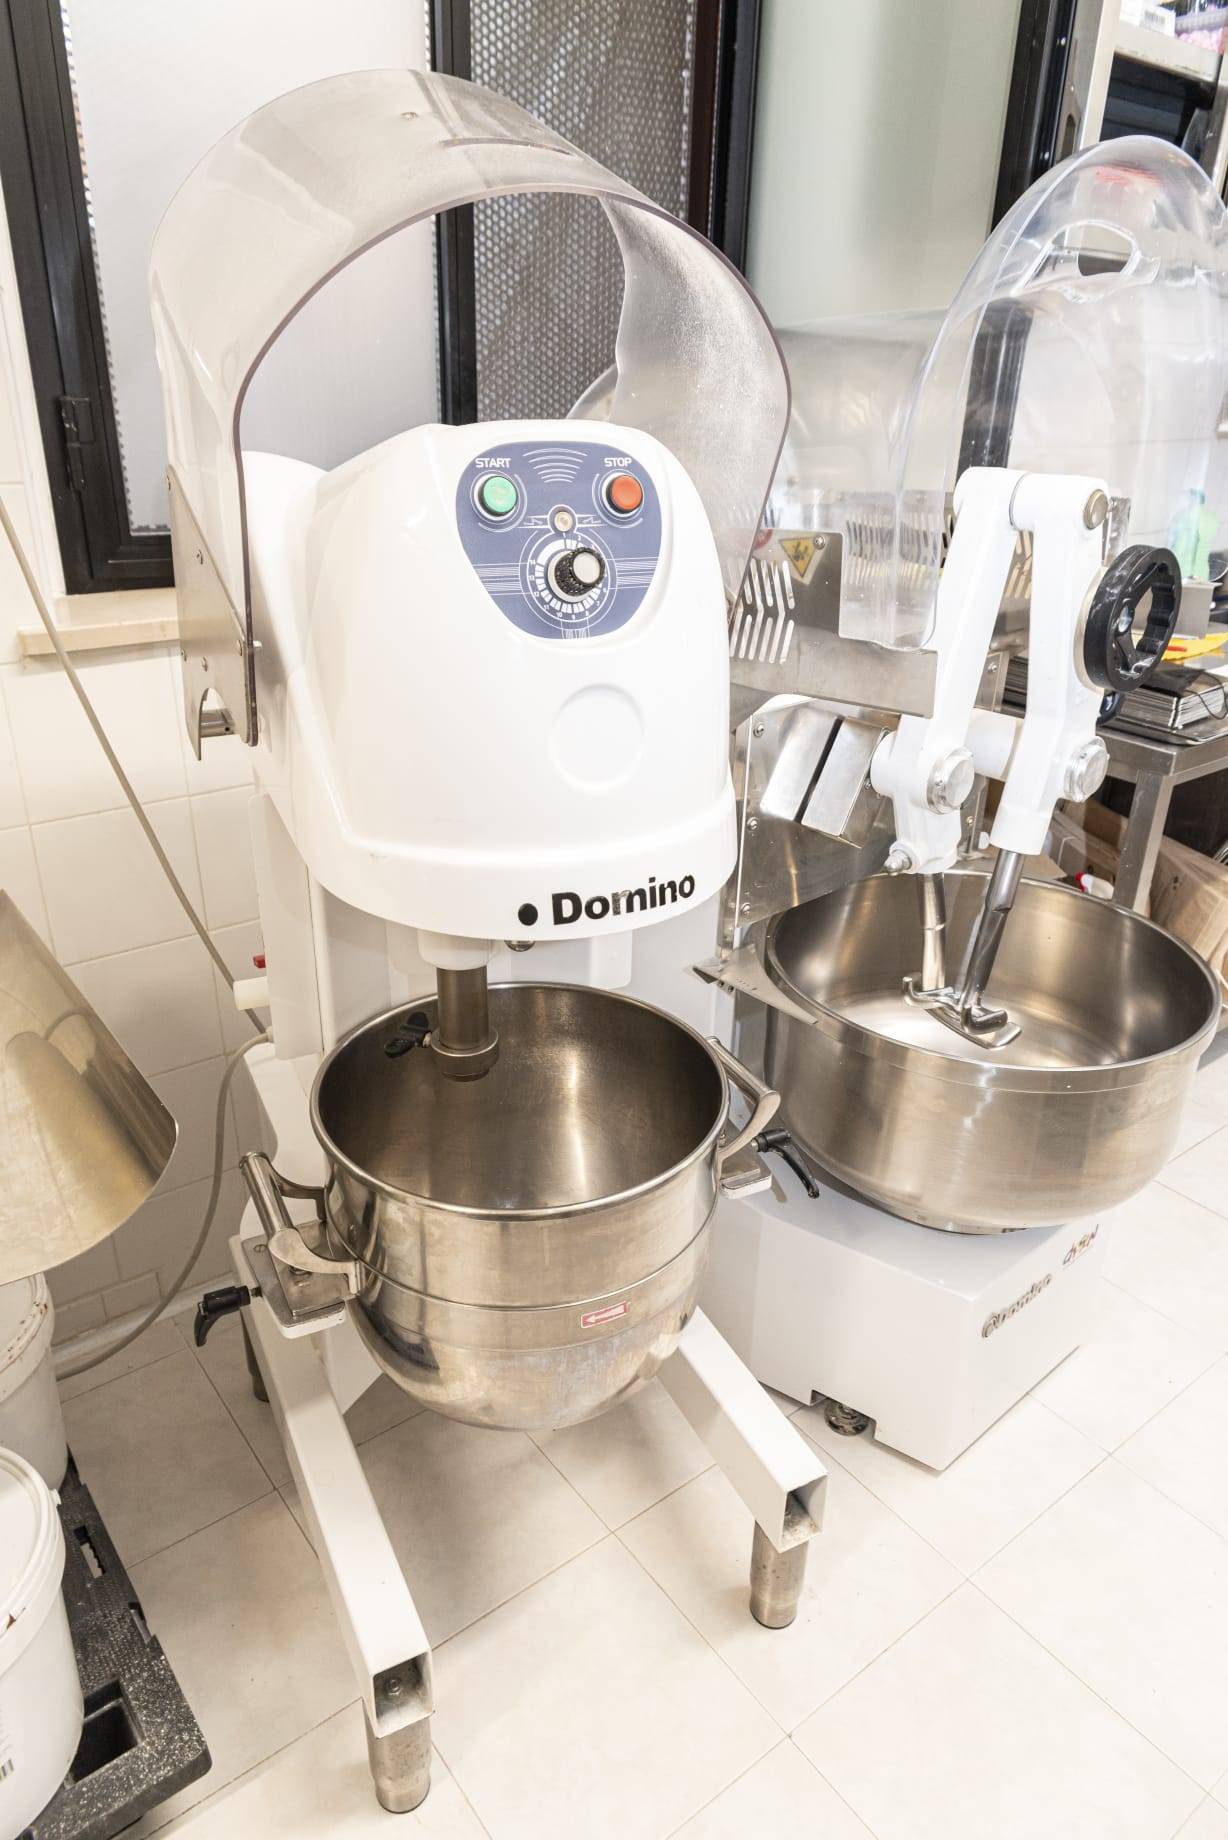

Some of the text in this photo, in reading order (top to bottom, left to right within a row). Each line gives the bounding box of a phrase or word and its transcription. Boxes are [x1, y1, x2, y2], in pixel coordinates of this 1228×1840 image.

[475, 457, 512, 468] START
[604, 457, 632, 467] STOP
[552, 874, 695, 926] Domino
